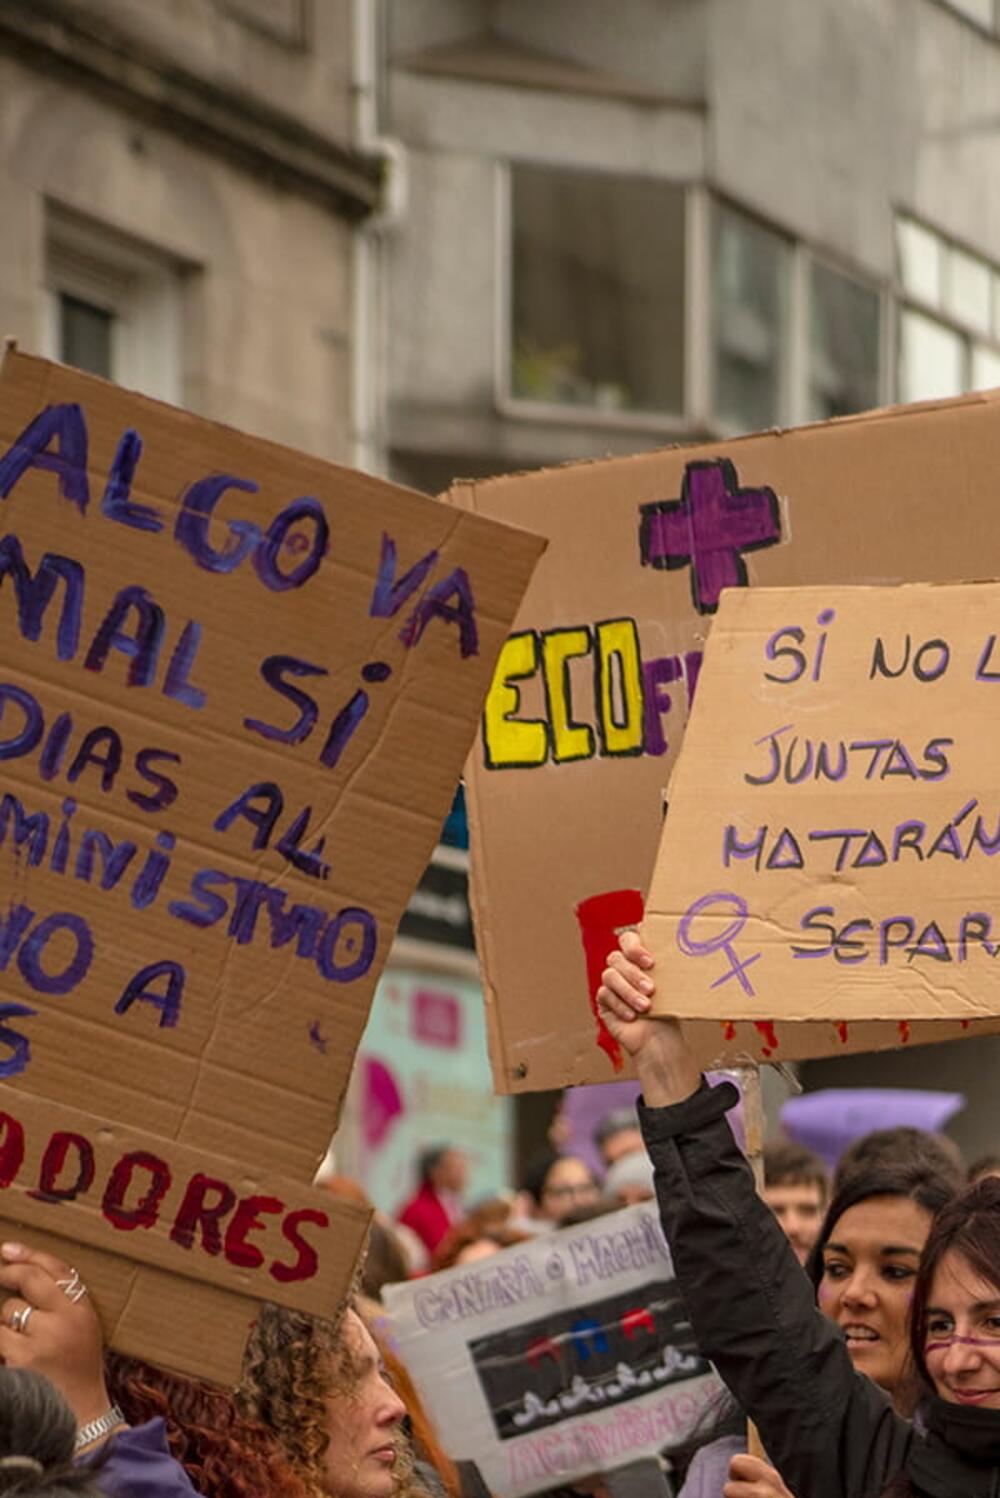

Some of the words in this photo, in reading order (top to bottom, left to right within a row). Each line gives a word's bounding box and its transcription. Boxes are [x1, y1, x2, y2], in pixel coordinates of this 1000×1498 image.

[0, 403, 330, 592] ALGO
[369, 531, 480, 659] VA
[0, 534, 206, 709] MAL
[870, 634, 950, 683] NO
[745, 724, 954, 786] JUNTAS
[213, 782, 331, 881] AL
[115, 959, 187, 1028] A
